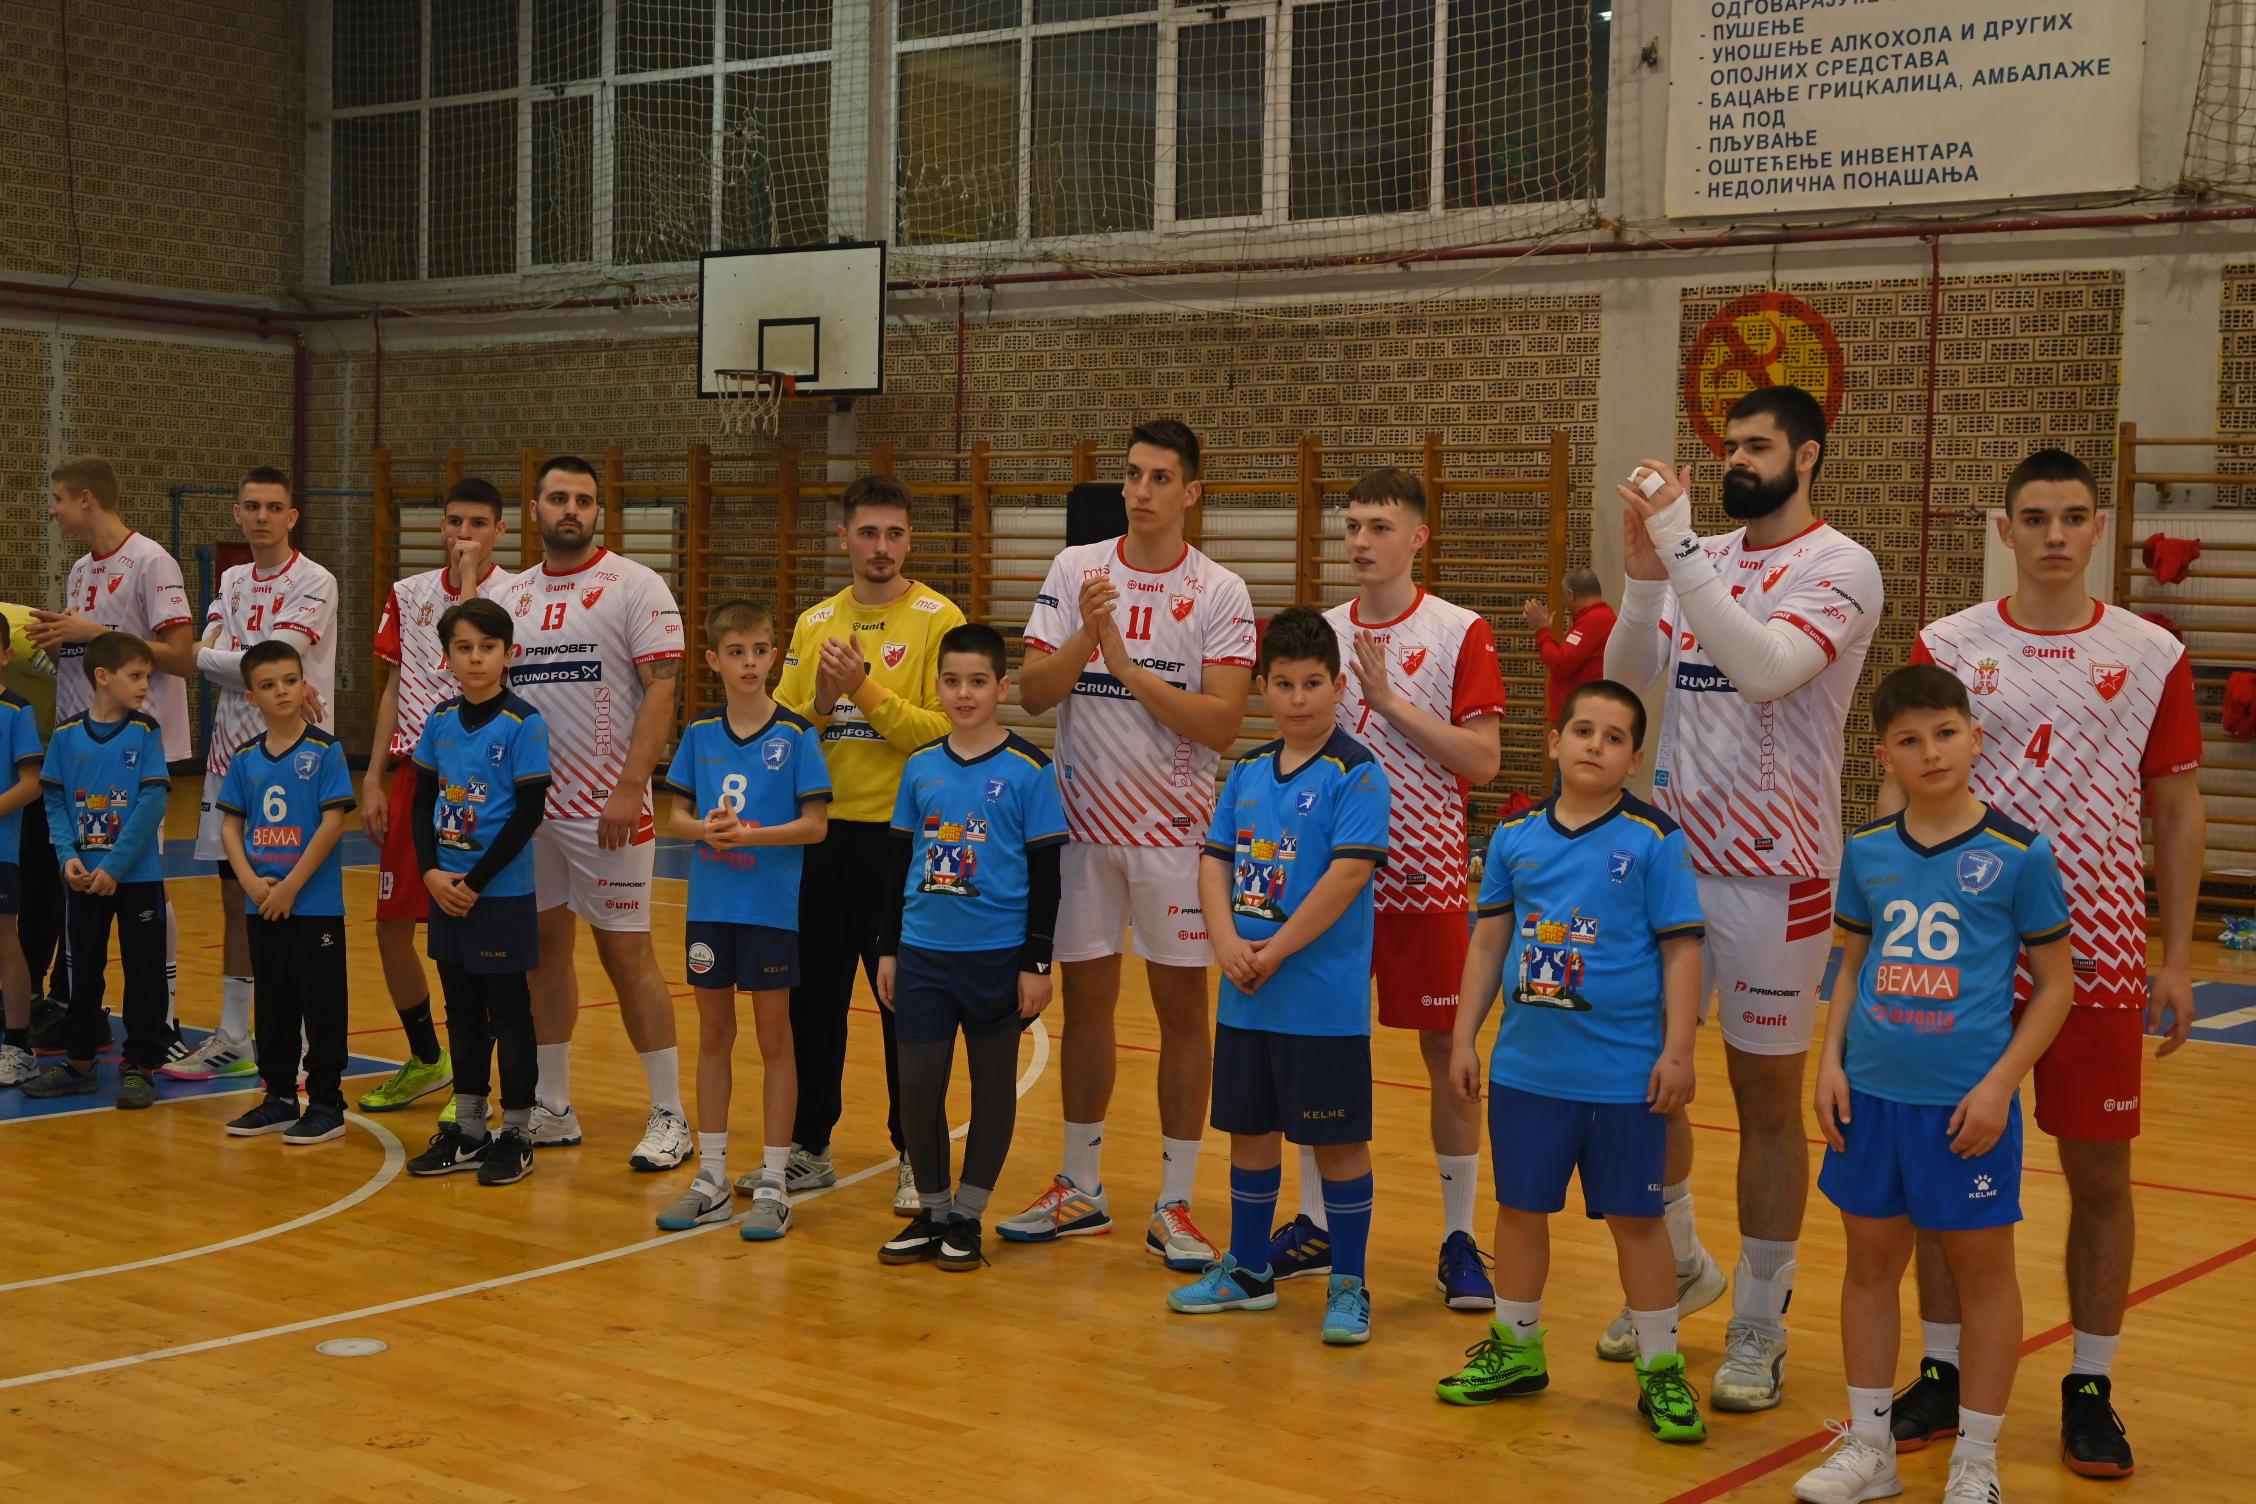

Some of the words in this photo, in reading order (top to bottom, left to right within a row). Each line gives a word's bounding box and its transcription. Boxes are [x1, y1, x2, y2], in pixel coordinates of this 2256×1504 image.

[1711, 0, 1879, 19] ОДГОВАРА
[1713, 17, 1804, 41] ПУШЕЊЕ
[1713, 38, 1822, 63] УНОШЕЊЕ
[1831, 26, 1952, 53] АЛКОХОЛА
[1961, 24, 1975, 40] И
[1984, 13, 2073, 41] ДРУГИХ
[1711, 62, 1808, 86] ОПОЈНИХ
[1816, 50, 1949, 77] СРЕДСТАВА
[1711, 85, 1799, 109] БАЦАЊЕ
[1808, 72, 1963, 99] ГРИЦКАЛИЦА,
[1972, 58, 2110, 87] АМБАЛАЖЕ
[1709, 114, 1734, 130] НА
[1743, 109, 1786, 129] ПОД
[1709, 129, 1817, 152] ПЉУВАЊЕ
[1708, 152, 1832, 176] ОШТЕЋЕЊЕ
[1841, 141, 1973, 167] ИНВЕНТАРА
[1708, 175, 1836, 199] НЕДОЛИЧНА
[1843, 164, 1979, 190] ПОНАШАЊА
[1739, 560, 1764, 570] uni
[594, 570, 620, 582] mts
[553, 582, 576, 592] unit
[1138, 582, 1164, 593] unit
[915, 598, 938, 610] mts
[1831, 586, 1864, 615] PRIMOBET
[247, 604, 264, 631] 21
[541, 602, 567, 631] 13
[1125, 605, 1153, 640] 11
[861, 621, 886, 631] unit
[1373, 634, 1392, 644] nit
[1809, 628, 1827, 646] unit
[525, 643, 598, 657] PRIMOBET
[2037, 646, 2076, 659] unit
[2023, 723, 2053, 768] 4
[2180, 760, 2199, 771] unit
[718, 773, 748, 815] 8
[263, 785, 287, 823] 6
[253, 828, 298, 846] BEMA
[615, 900, 639, 910] unit
[1190, 930, 1209, 940] uni
[1881, 900, 1960, 961] 26
[2079, 958, 2095, 966] unit
[1876, 965, 1954, 997] BEMA
[1434, 994, 1459, 1006] unit
[1749, 987, 1801, 997] PRIMOBET
[1756, 1014, 1787, 1026] unit
[2116, 1095, 2138, 1112] unit
[1303, 1109, 1345, 1119] KELME
[1647, 1183, 1661, 1191] KEL
[1969, 1188, 1998, 1199] KELME
